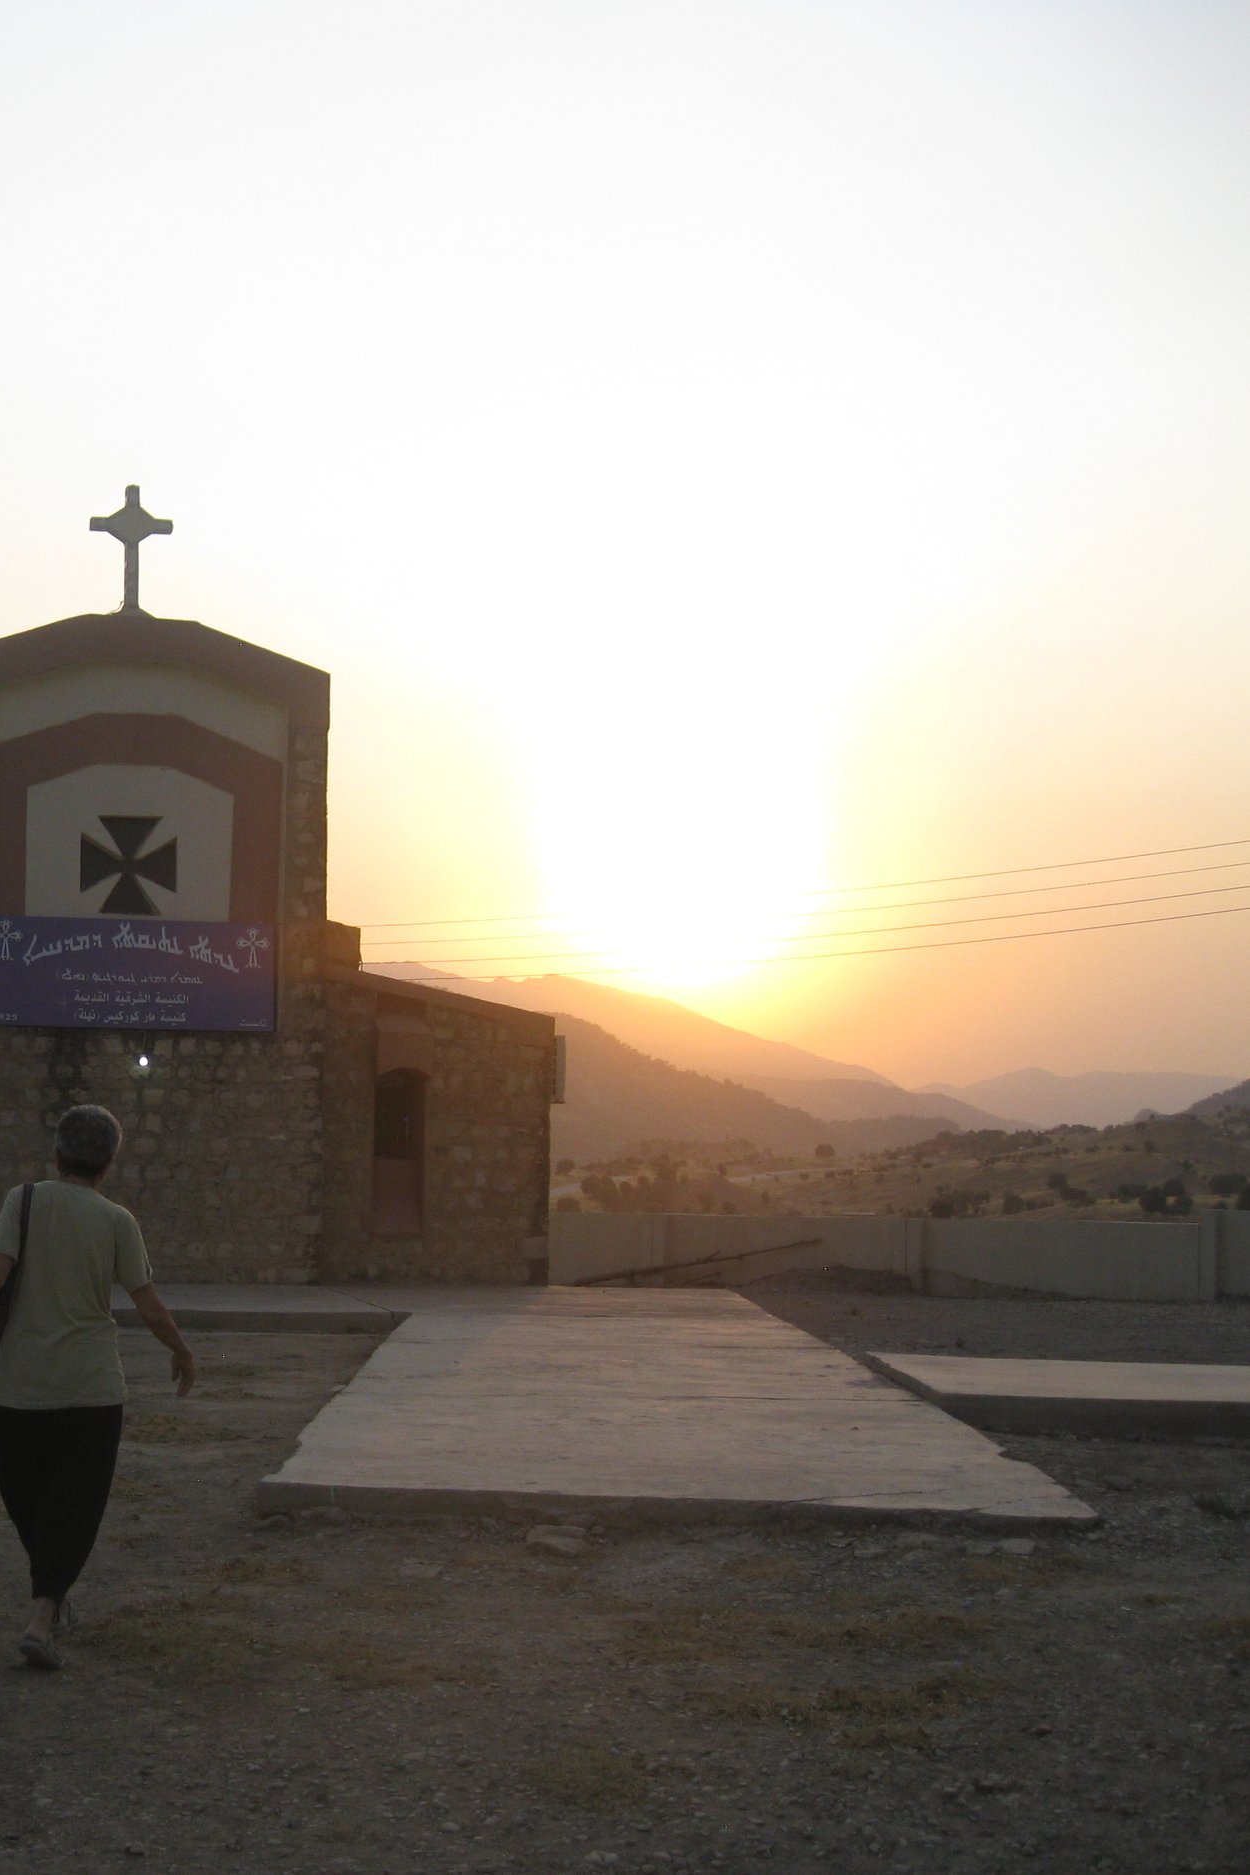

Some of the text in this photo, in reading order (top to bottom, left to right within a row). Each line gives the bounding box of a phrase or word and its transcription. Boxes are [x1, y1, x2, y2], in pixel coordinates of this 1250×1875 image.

[73, 988, 189, 1007] الكنيسة الشرقية القديمة
[160, 1009, 187, 1025] كنيسة
